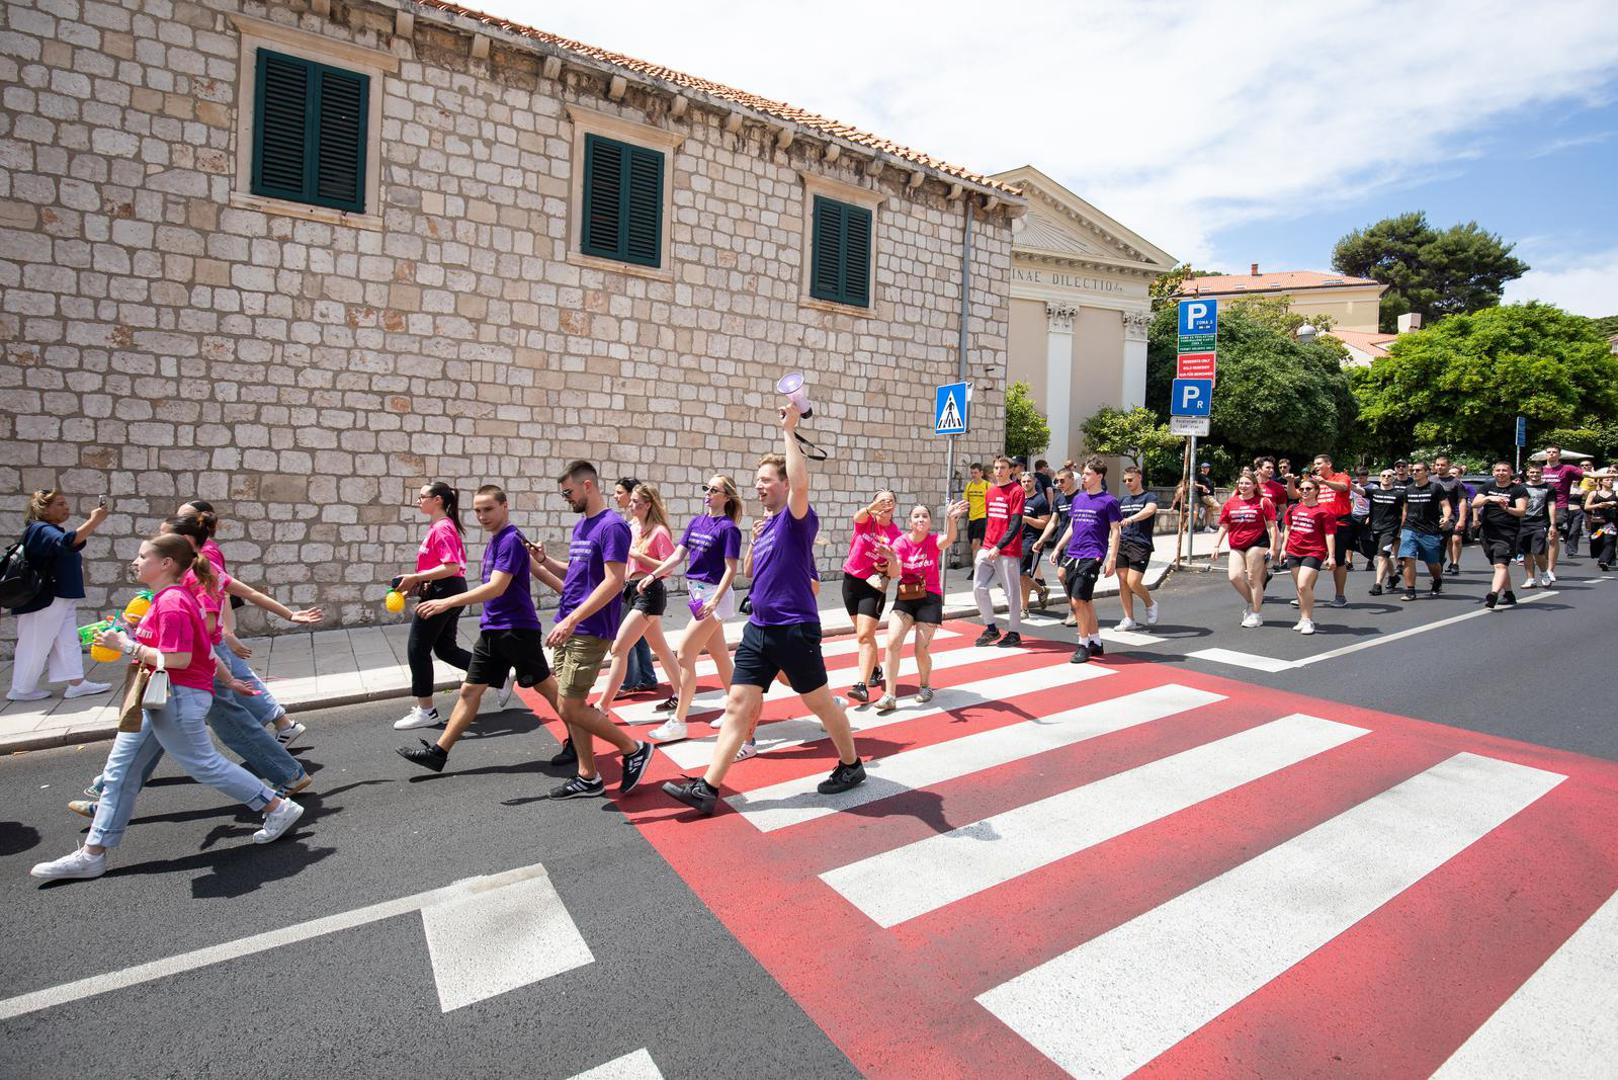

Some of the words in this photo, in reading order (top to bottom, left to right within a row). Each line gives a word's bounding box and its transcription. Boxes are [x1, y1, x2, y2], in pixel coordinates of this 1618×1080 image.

[1188, 303, 1207, 329] P
[1183, 386, 1200, 409] P
[1197, 401, 1204, 409] R
